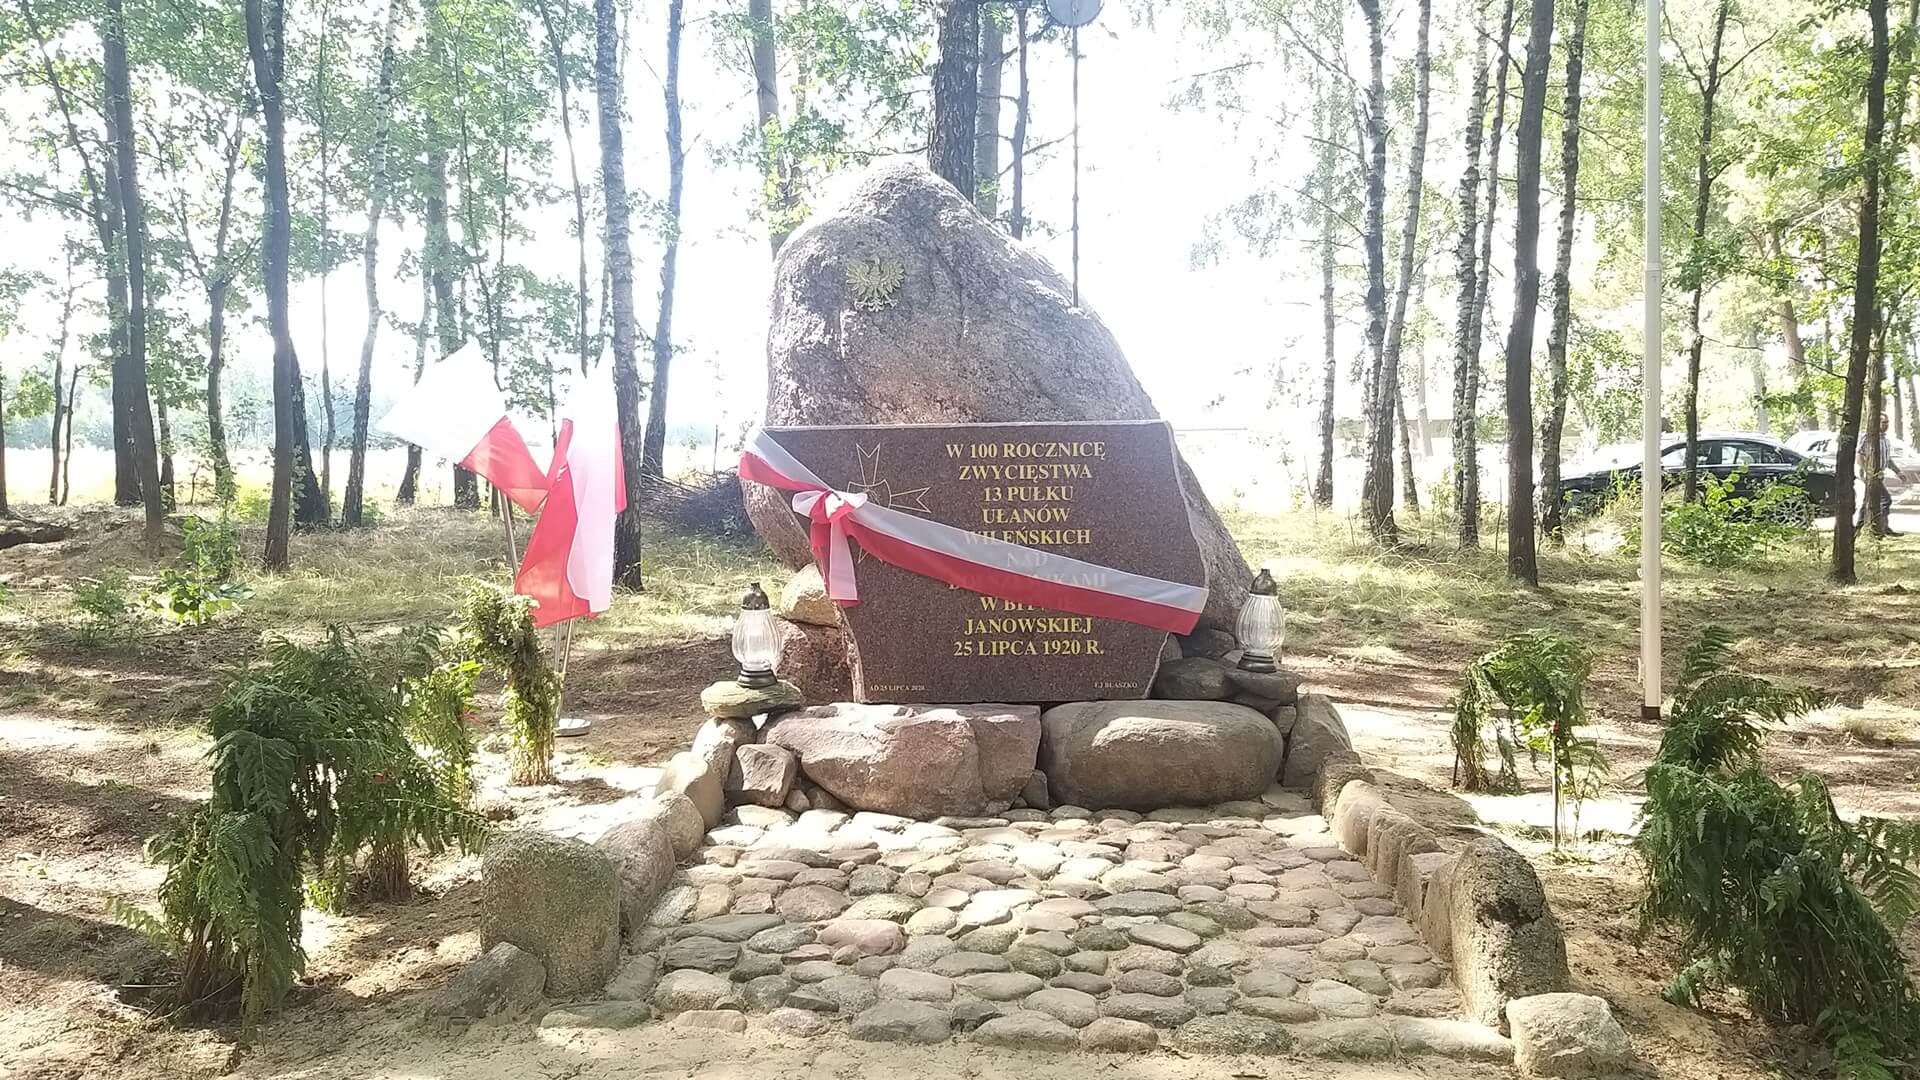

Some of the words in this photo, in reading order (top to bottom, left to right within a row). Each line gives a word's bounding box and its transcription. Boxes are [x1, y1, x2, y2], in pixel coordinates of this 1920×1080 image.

[946, 444, 964, 458] W
[970, 443, 997, 458] 100
[1003, 442, 1105, 460] ROCZNICĘ
[959, 464, 1093, 482] ZWYCIĘSTWA
[984, 487, 1002, 502] 13
[1008, 486, 1074, 501] PUŁKU
[983, 505, 1071, 524] UŁANÓW
[981, 597, 997, 611] W
[965, 617, 1093, 635] JANOWSKIEJ
[954, 641, 973, 656] 25
[978, 640, 1037, 656] LIPCA
[1043, 640, 1081, 655] 1920
[1086, 640, 1105, 655] R.
